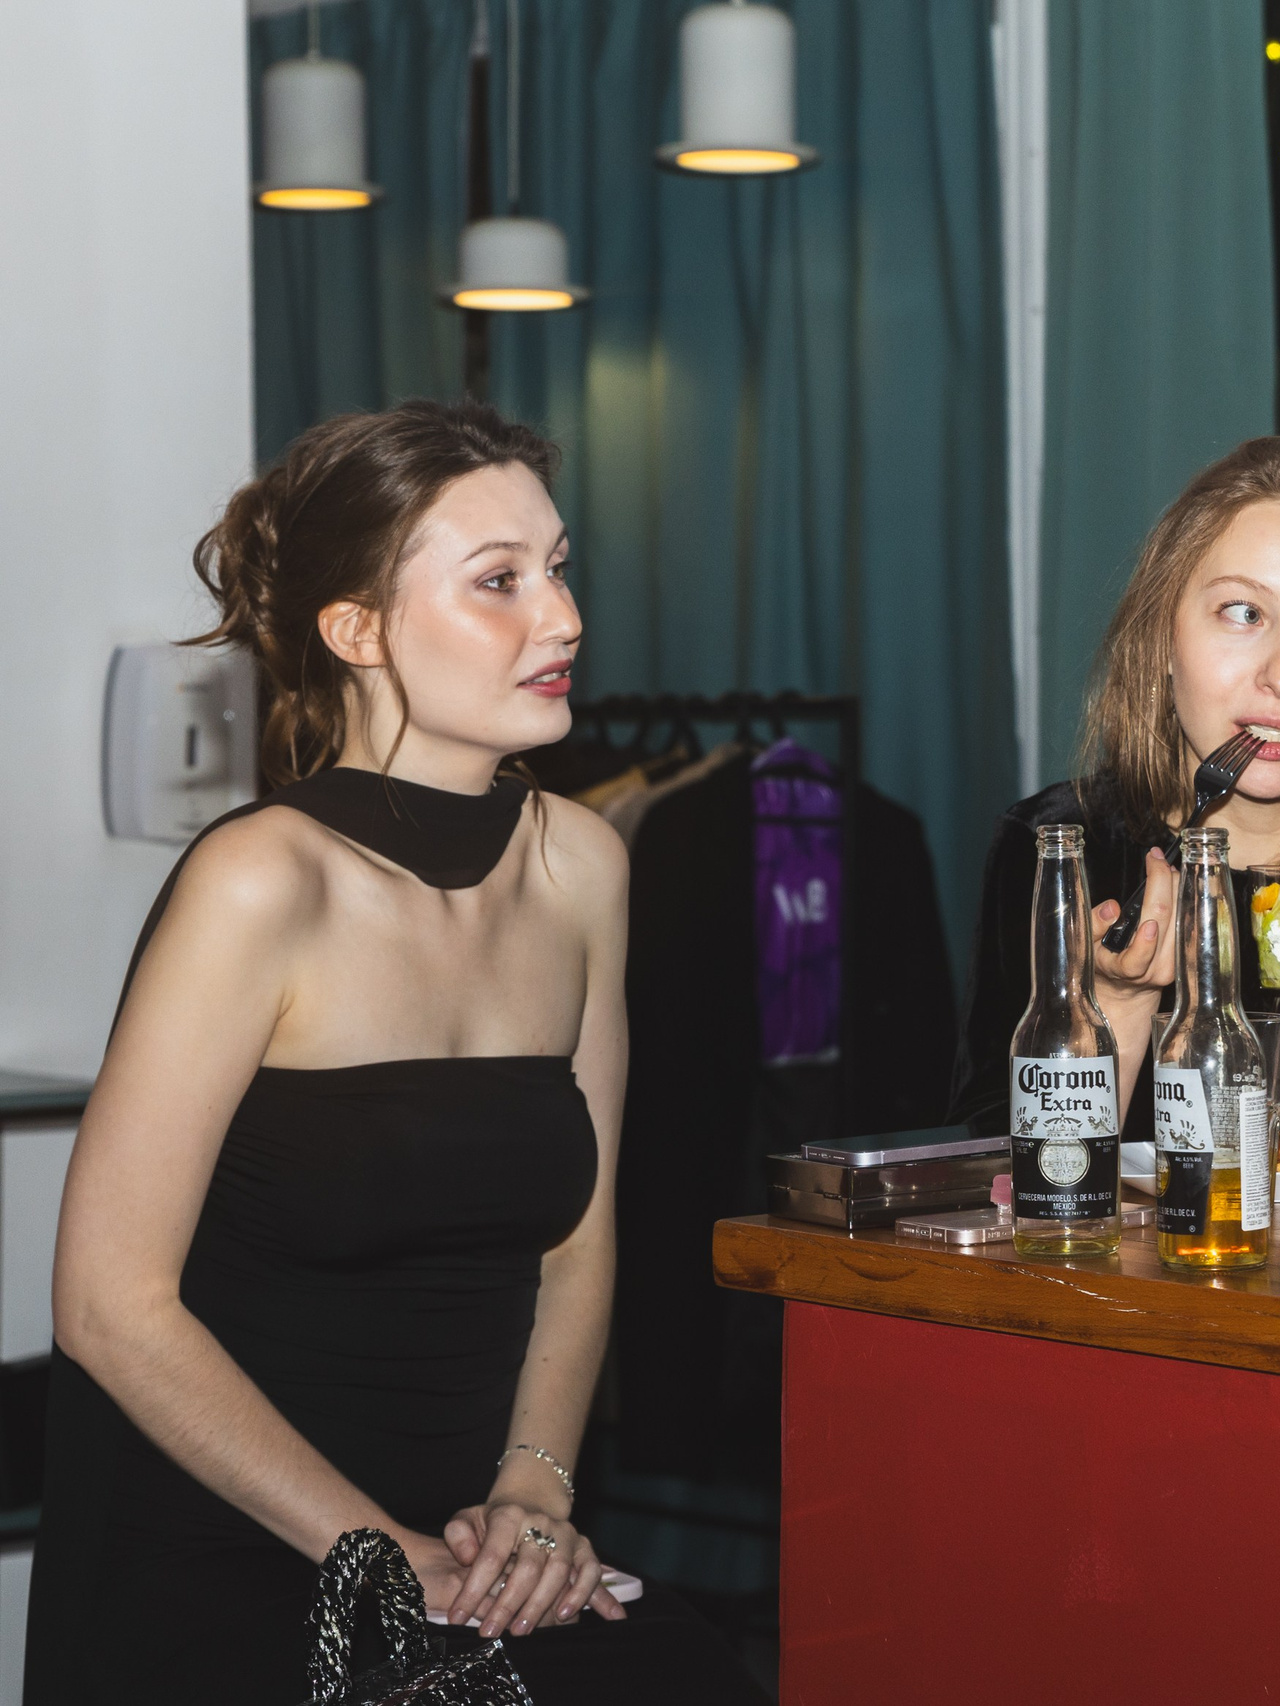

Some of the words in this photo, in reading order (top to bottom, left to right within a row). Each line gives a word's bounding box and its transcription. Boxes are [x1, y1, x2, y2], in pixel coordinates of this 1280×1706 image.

[1018, 1063, 1107, 1097] Corona
[1040, 1091, 1092, 1111] Extra
[1154, 1081, 1187, 1102] ona
[1080, 1194, 1087, 1202] DE
